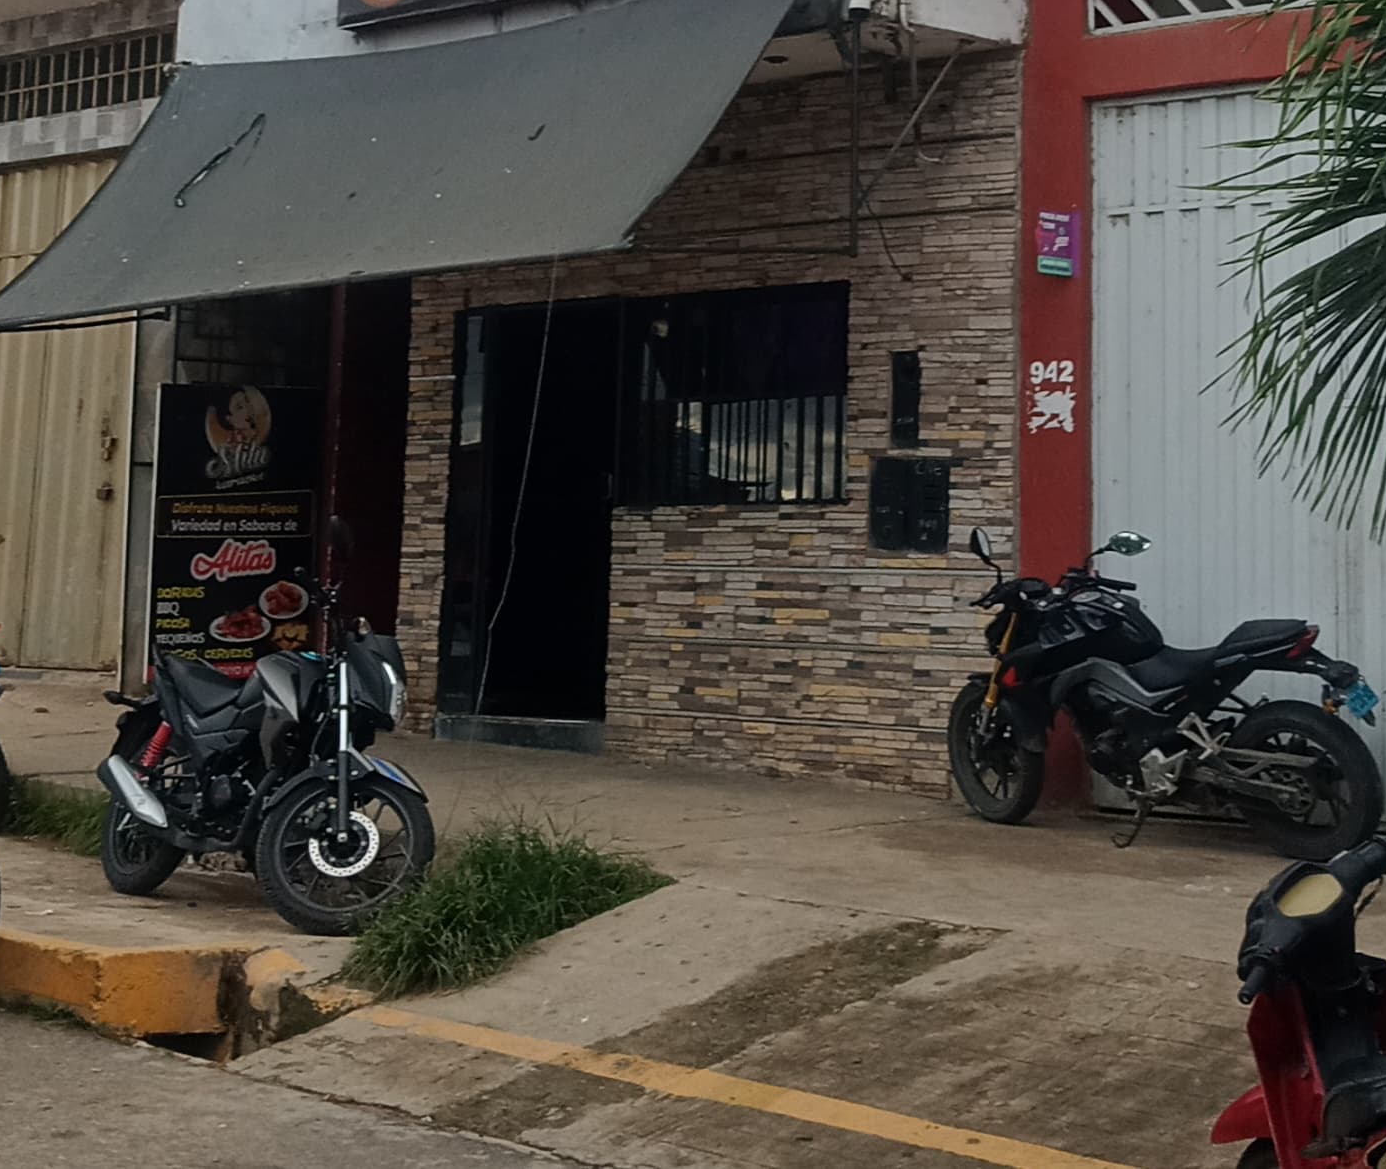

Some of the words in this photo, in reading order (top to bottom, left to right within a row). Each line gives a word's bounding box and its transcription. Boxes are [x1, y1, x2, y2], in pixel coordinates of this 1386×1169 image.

[1029, 360, 1075, 384] 942
[171, 518, 220, 532] Variedad
[222, 521, 237, 532] en
[238, 518, 282, 532] Sabores
[283, 518, 298, 532] de
[191, 538, 276, 582] Alitas
